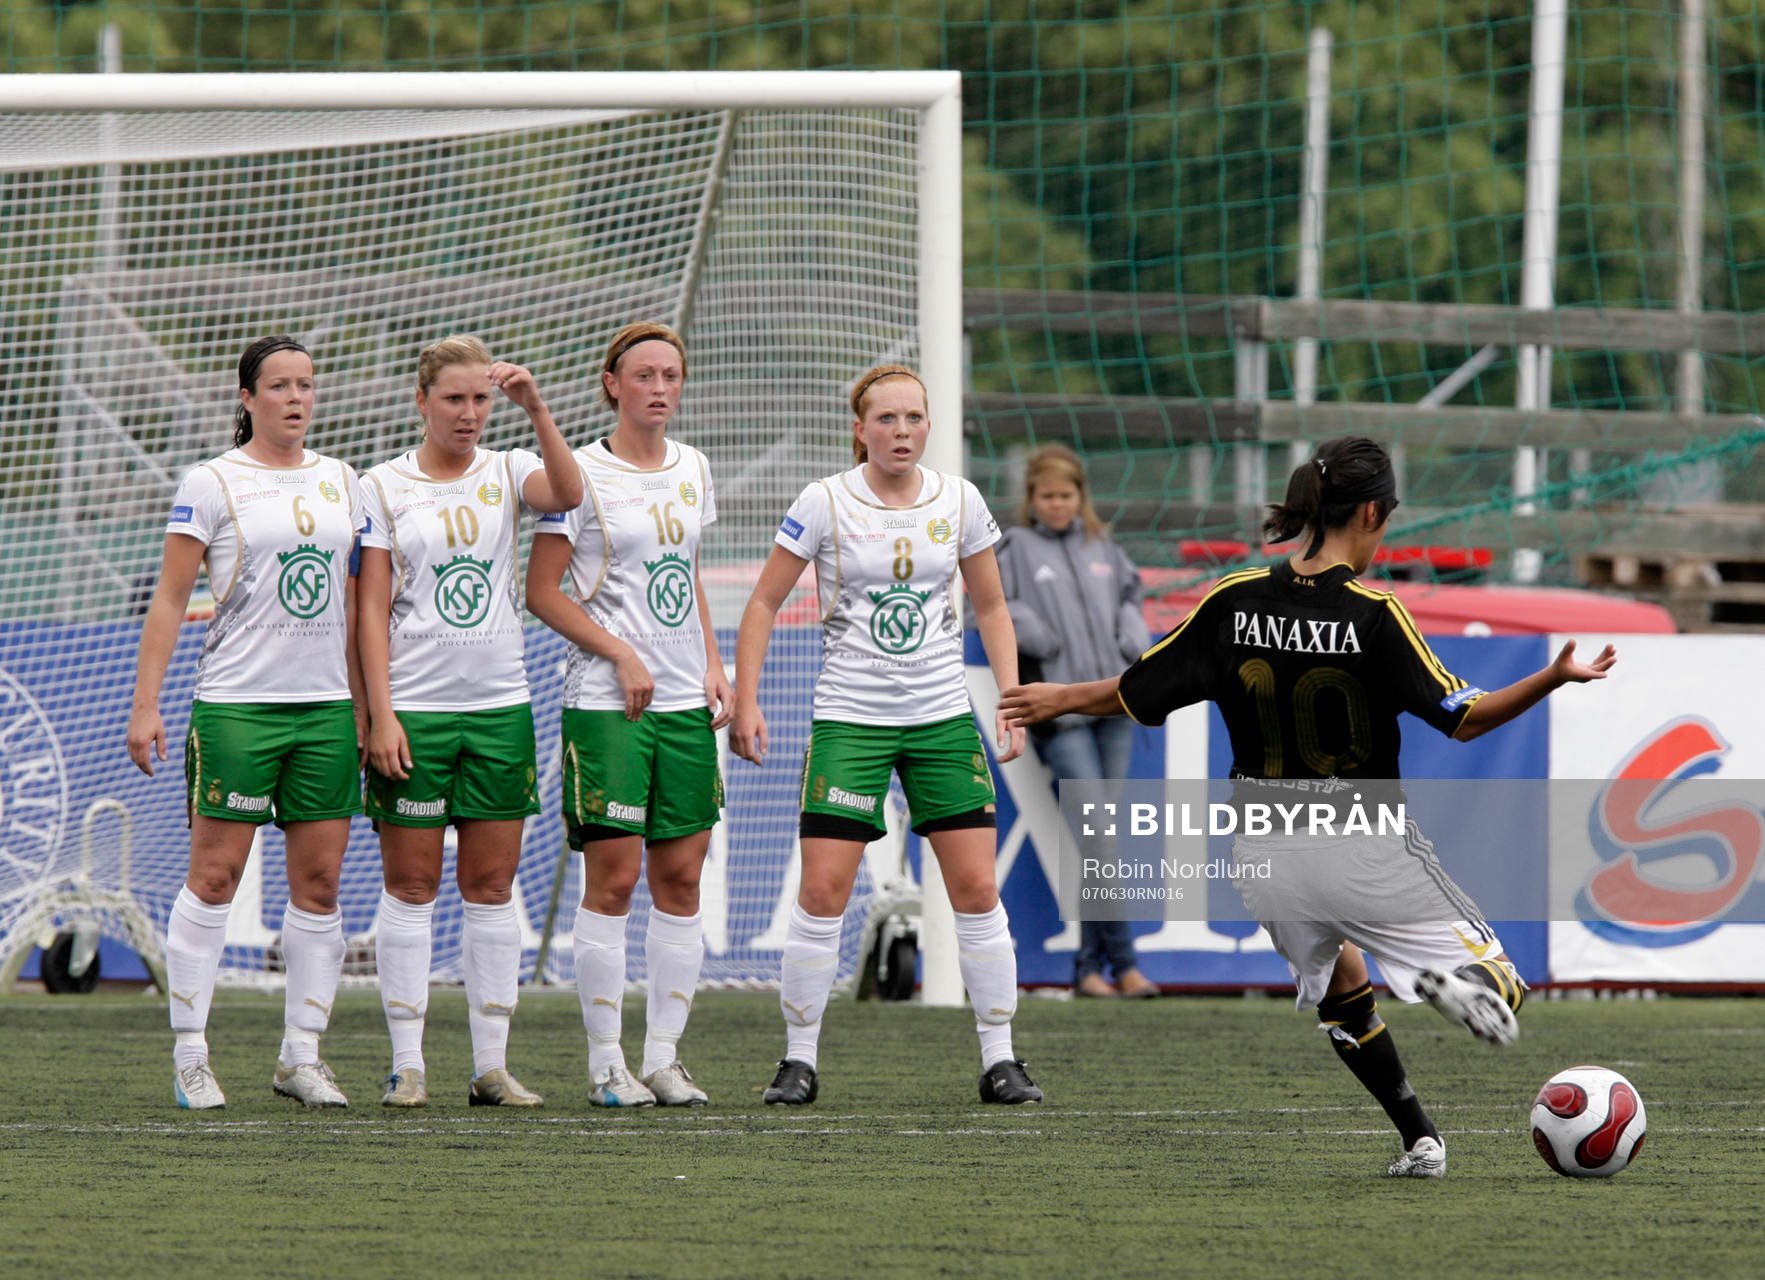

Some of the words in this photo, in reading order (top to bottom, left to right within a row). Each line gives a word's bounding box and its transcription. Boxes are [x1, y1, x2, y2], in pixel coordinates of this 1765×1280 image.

[293, 495, 316, 537] 6
[437, 505, 480, 548] 10
[647, 501, 685, 546] 16
[893, 536, 914, 581] 8
[287, 564, 326, 611] KSF
[443, 574, 484, 620] KSF
[656, 572, 687, 619] KSF
[879, 602, 919, 648] KSF
[1233, 611, 1363, 654] PANAXIA
[1238, 658, 1373, 778] 10
[227, 792, 270, 811] STADIUM
[396, 797, 447, 816] STADIUM
[607, 800, 647, 822] STADI
[828, 786, 877, 812] STADIUM
